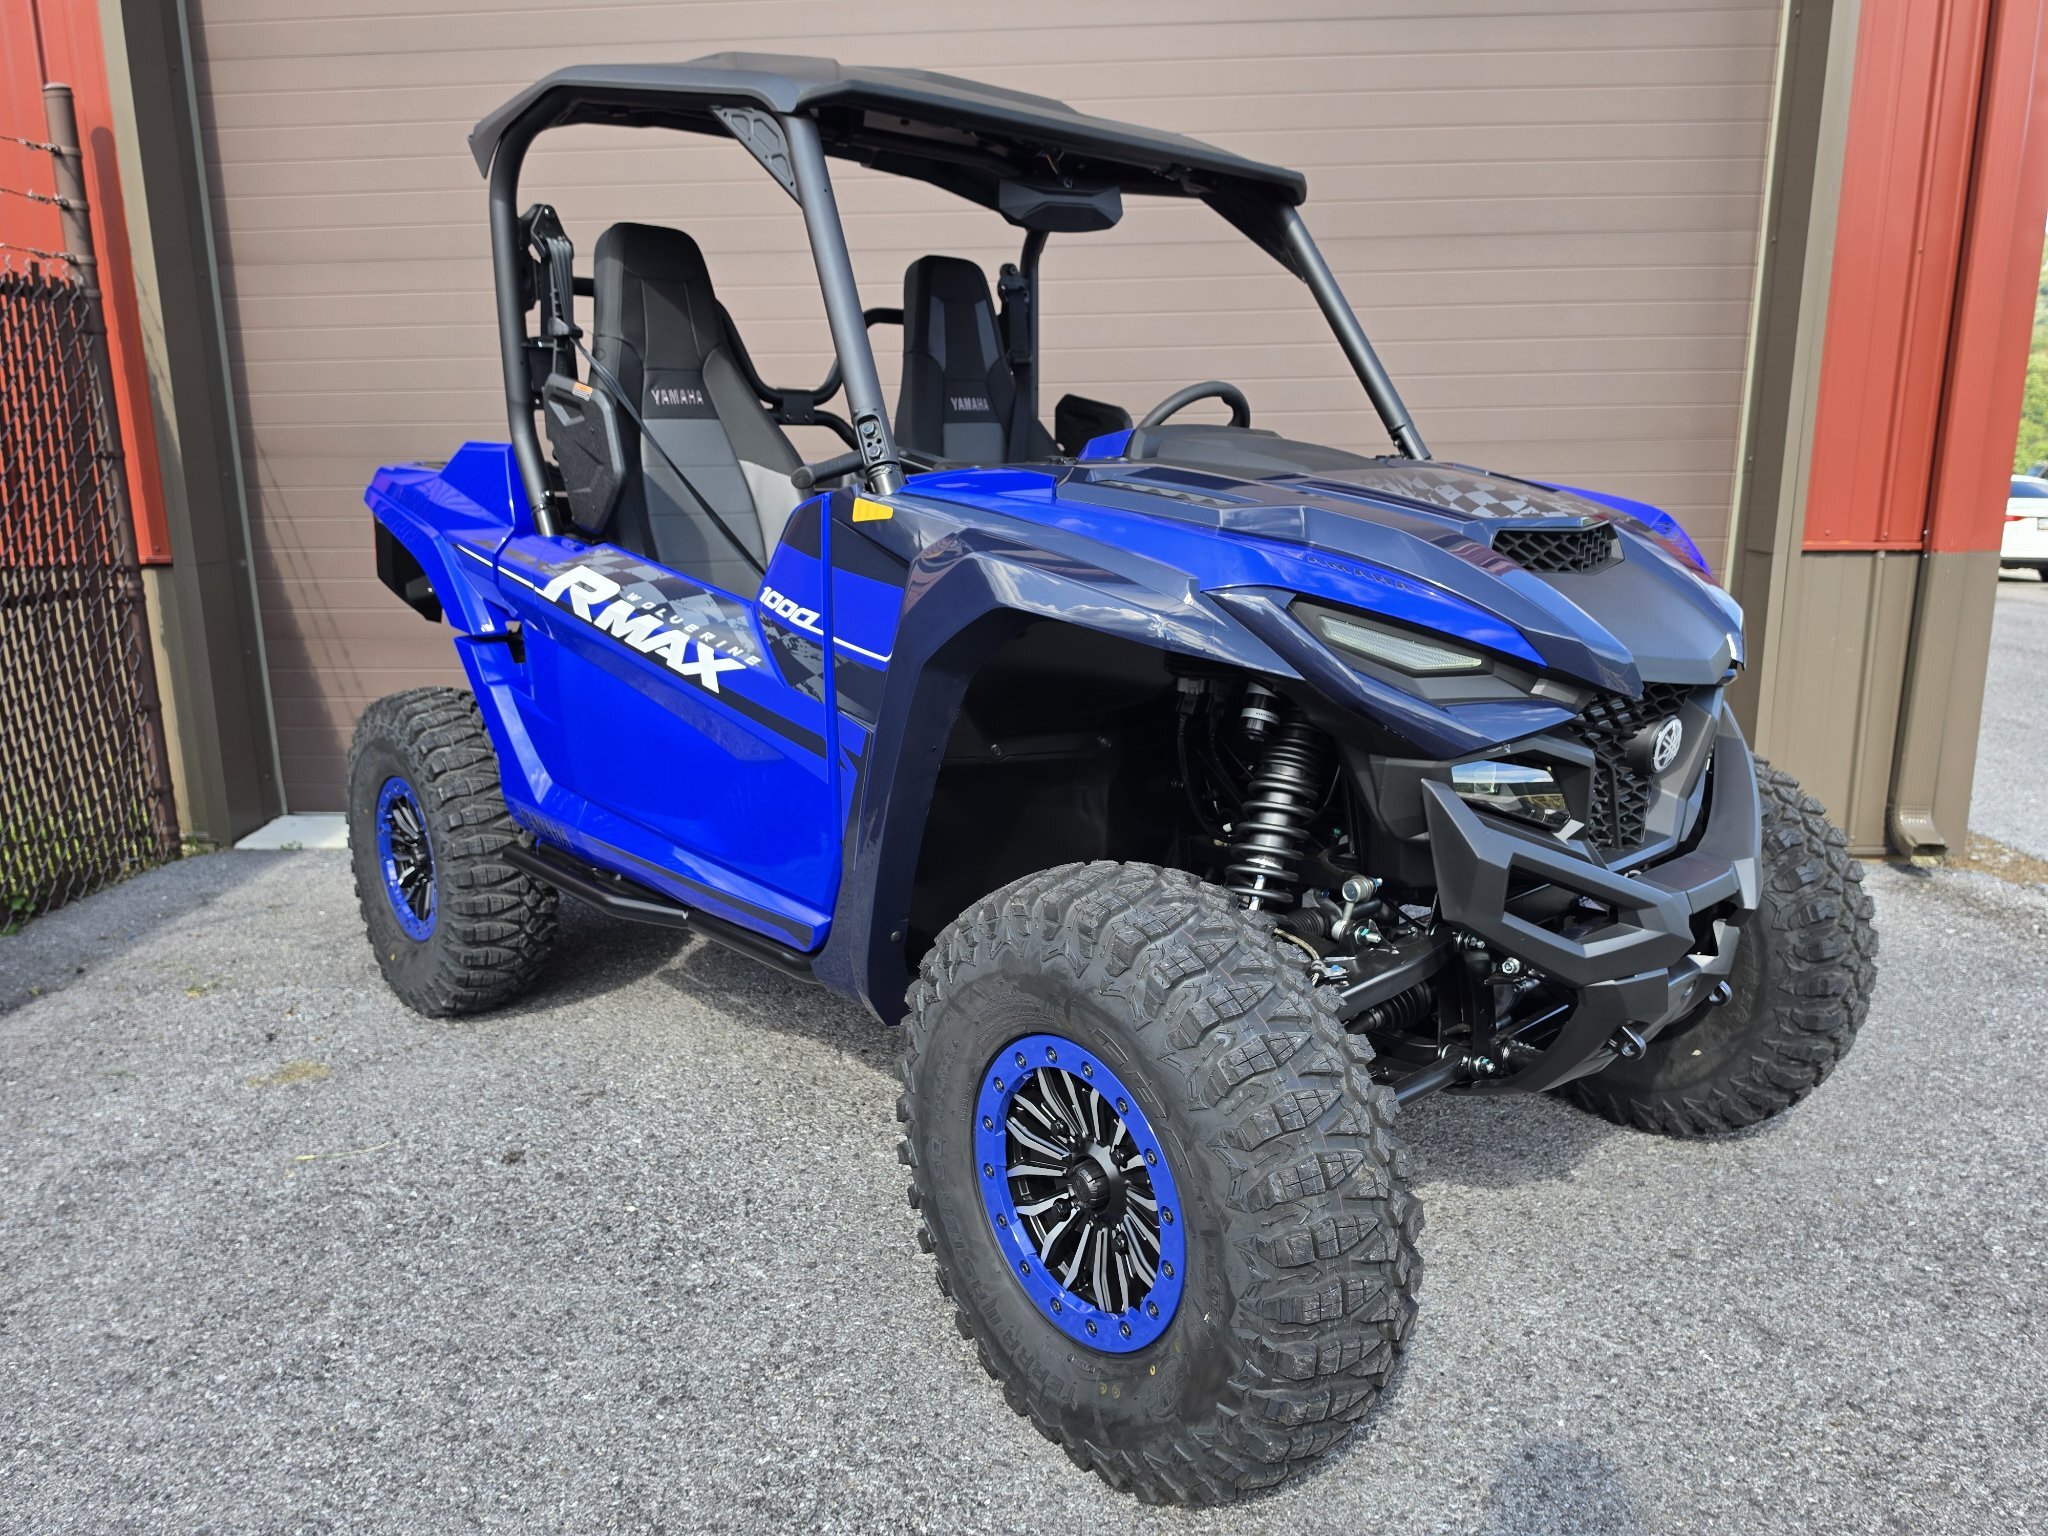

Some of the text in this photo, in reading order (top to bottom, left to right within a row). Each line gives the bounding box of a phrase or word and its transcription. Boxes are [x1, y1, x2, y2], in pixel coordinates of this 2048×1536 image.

[651, 388, 704, 405] YAMAHA
[950, 397, 990, 411] YAMAHA
[540, 565, 747, 694] RMAX
